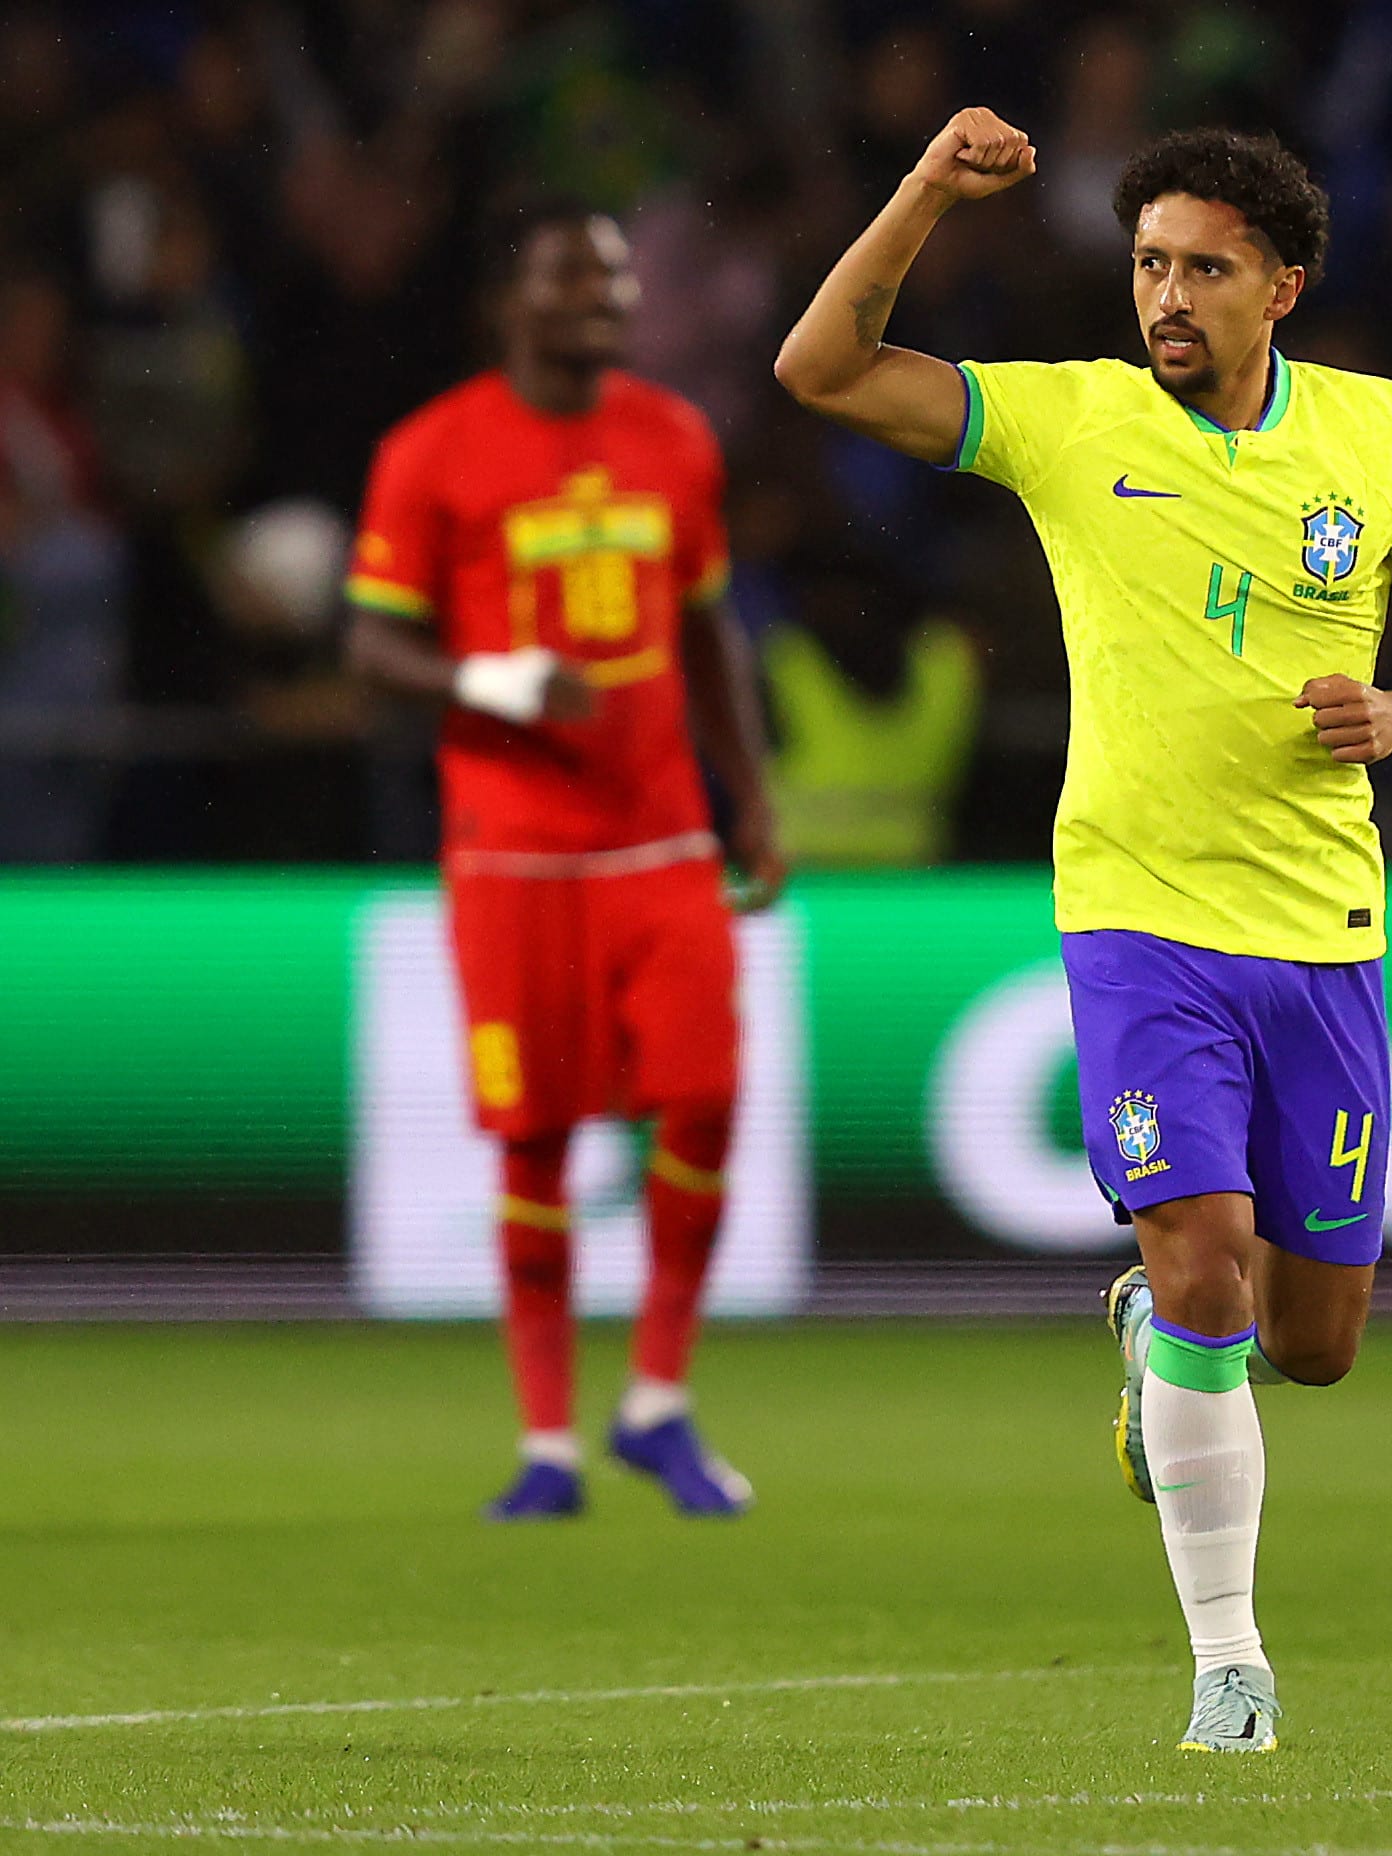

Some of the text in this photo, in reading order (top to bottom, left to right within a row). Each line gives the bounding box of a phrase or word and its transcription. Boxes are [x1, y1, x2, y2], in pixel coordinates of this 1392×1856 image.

[1319, 537, 1342, 548] CBF
[1293, 583, 1349, 600] BRASIL
[1204, 562, 1252, 657] 4
[1329, 1108, 1374, 1203] 4
[1125, 1158, 1172, 1182] BRASIL
